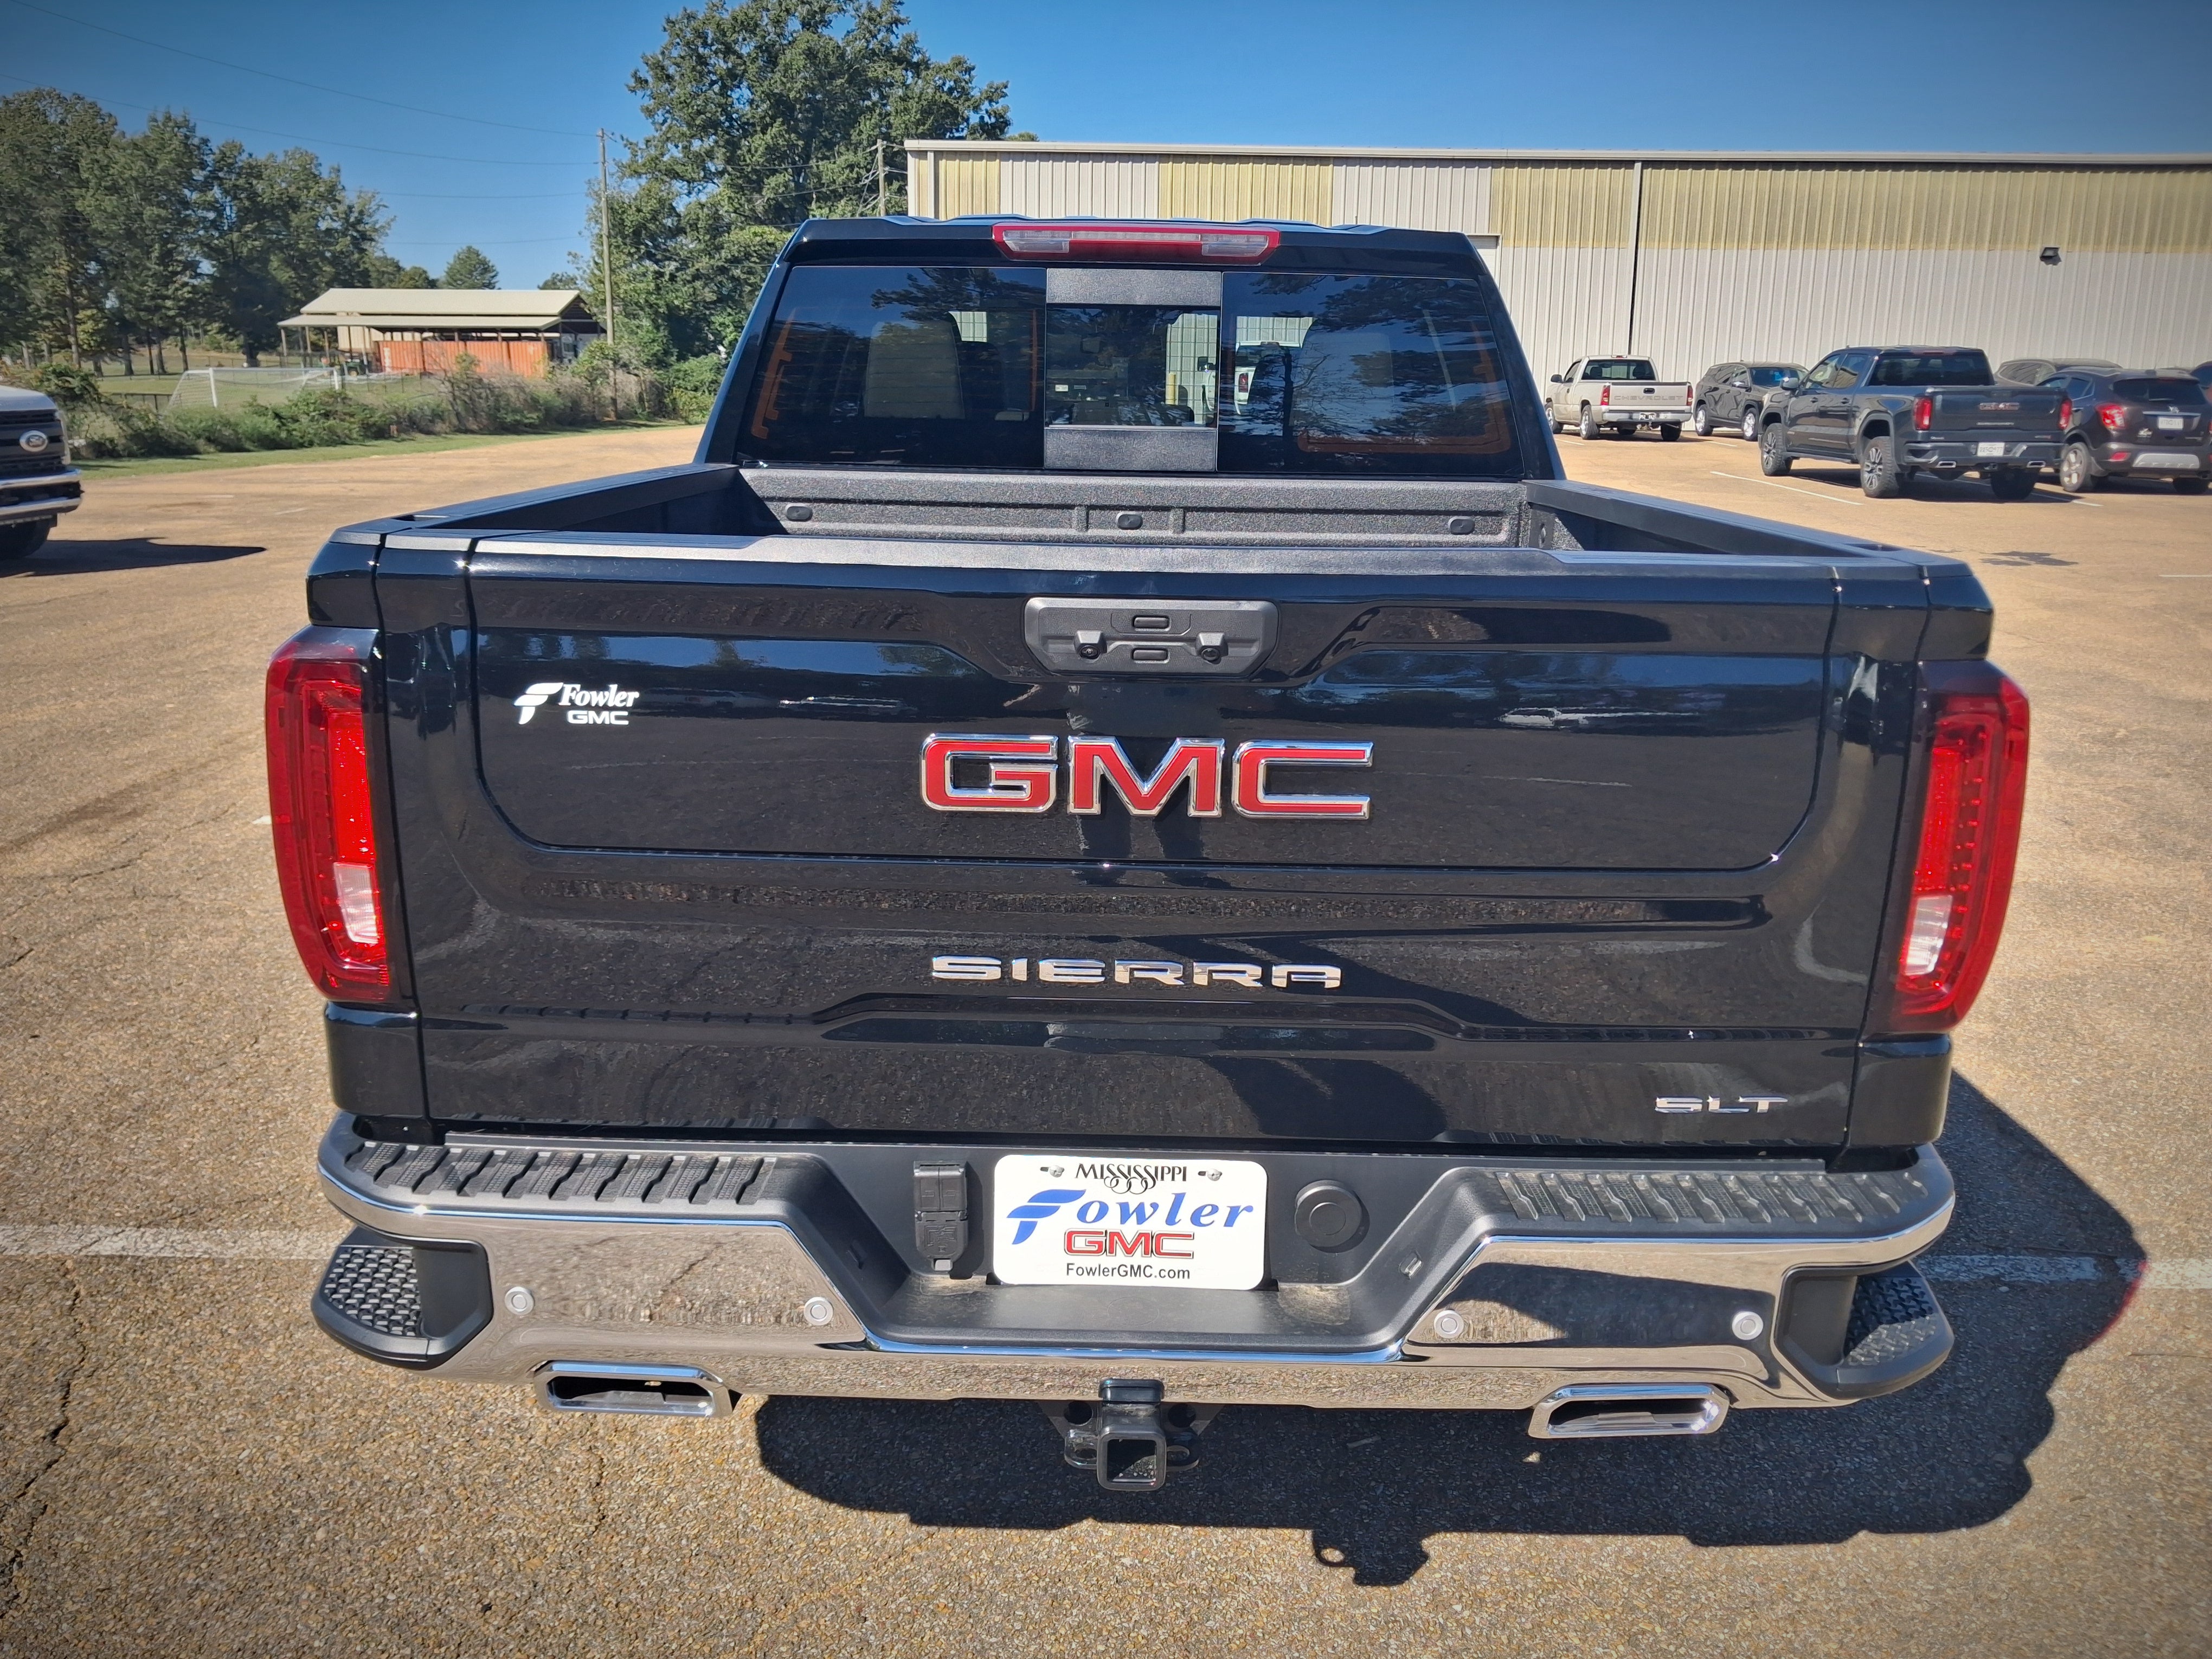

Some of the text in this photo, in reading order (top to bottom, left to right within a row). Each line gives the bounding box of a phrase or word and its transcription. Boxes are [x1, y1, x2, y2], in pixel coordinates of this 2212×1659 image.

[558, 683, 640, 707] Fowler
[567, 710, 629, 725] GMC
[919, 733, 1373, 820] GMC
[932, 956, 1342, 988] SIERRA
[1655, 1095, 1788, 1113] SLT
[1075, 1163, 1187, 1194] MISSISSIPPI
[1007, 1189, 1254, 1245] Fowler
[1064, 1227, 1194, 1259] GMC
[1066, 1263, 1191, 1279] FowlerGMC.com
